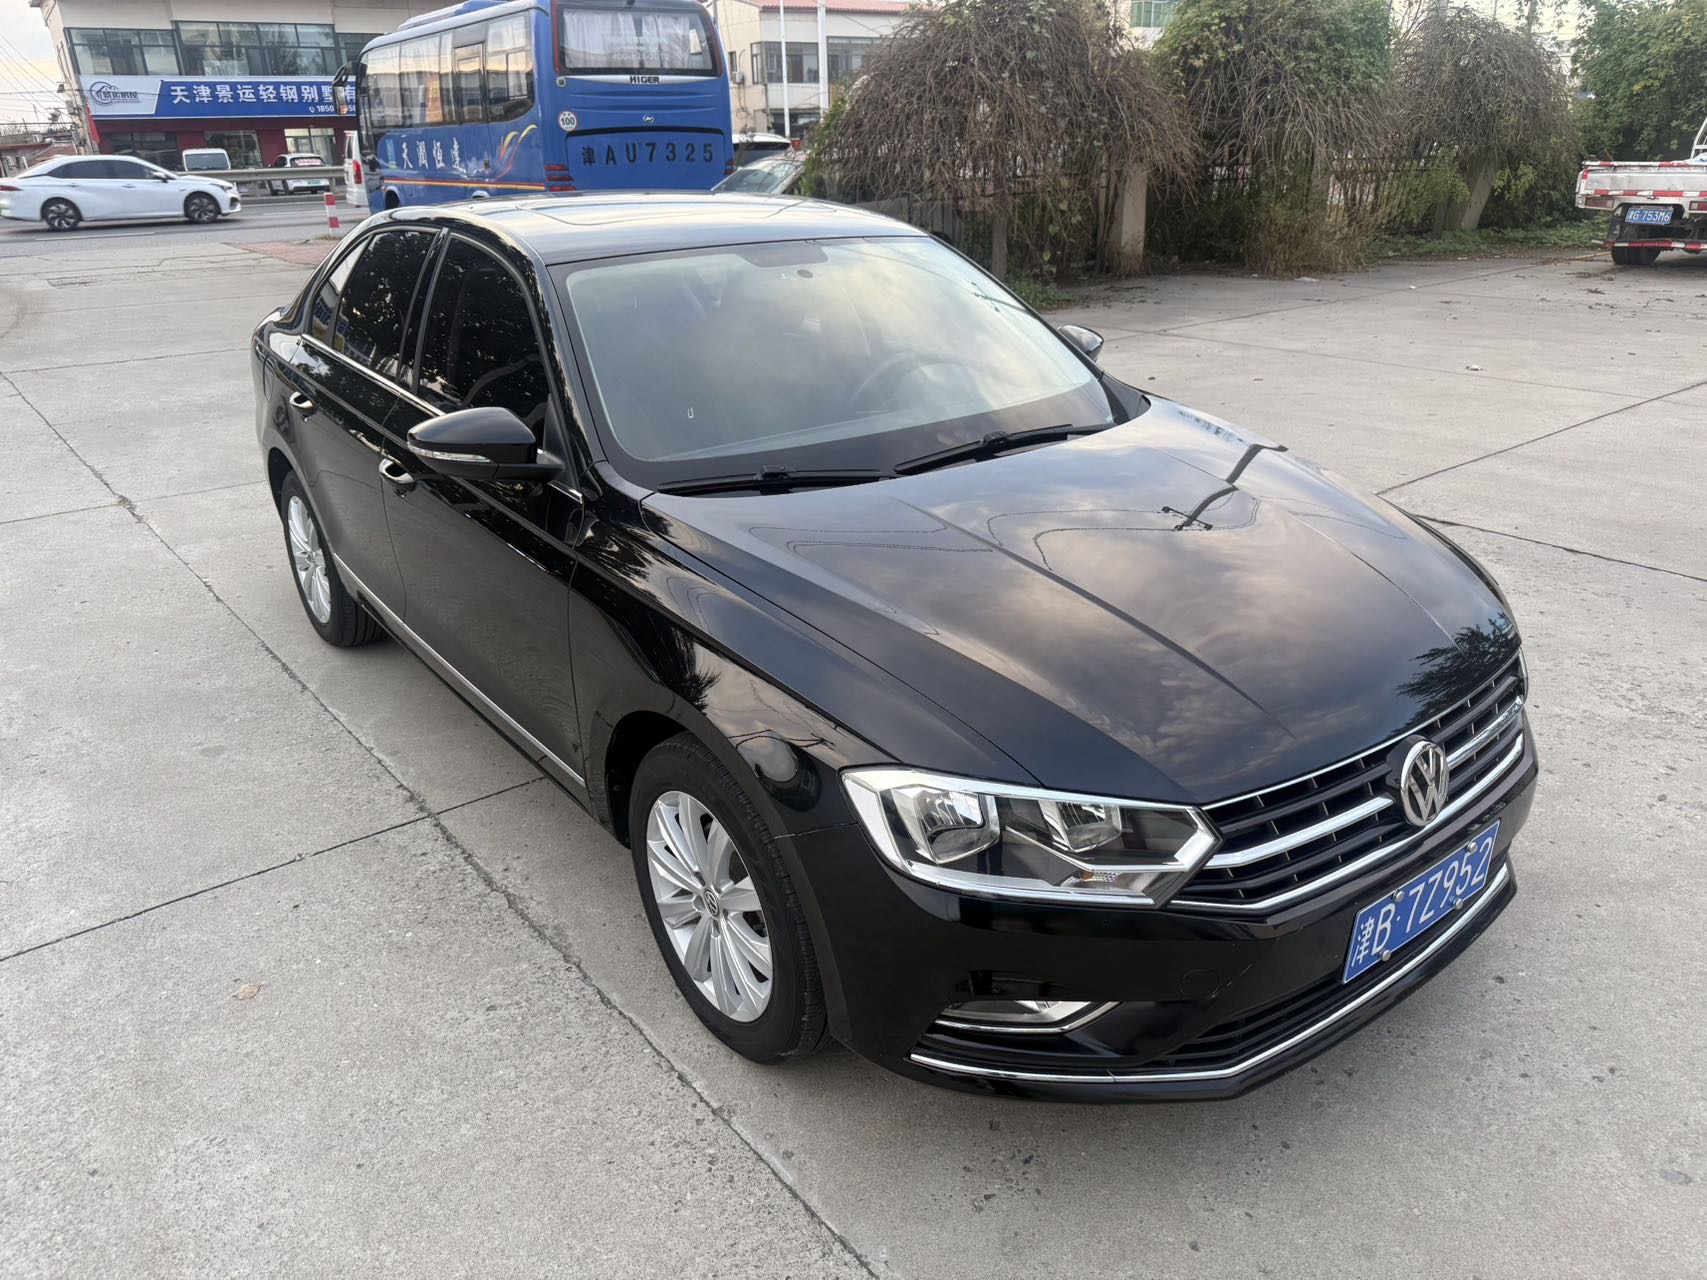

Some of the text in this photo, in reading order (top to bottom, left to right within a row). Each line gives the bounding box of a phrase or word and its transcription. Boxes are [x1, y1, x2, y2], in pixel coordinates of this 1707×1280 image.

[629, 76, 660, 84] HIGER
[561, 116, 576, 126] 100
[581, 142, 713, 165] 津AU7325
